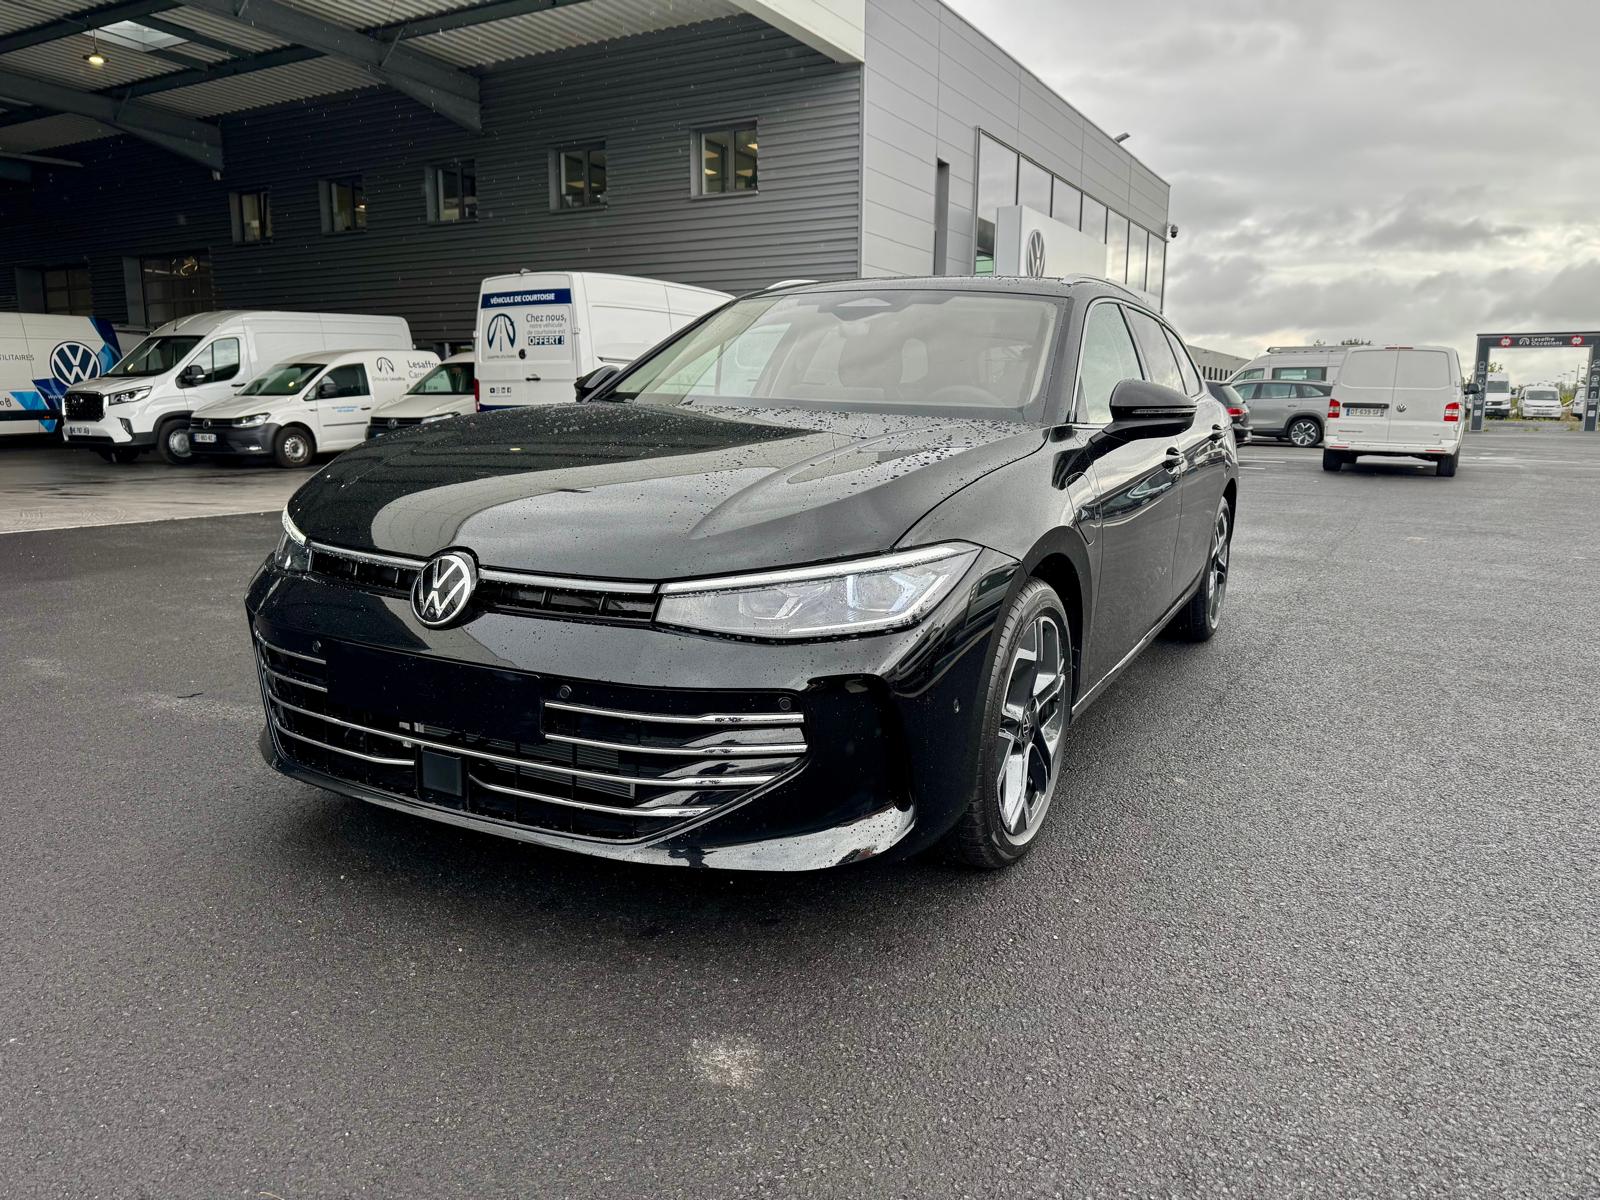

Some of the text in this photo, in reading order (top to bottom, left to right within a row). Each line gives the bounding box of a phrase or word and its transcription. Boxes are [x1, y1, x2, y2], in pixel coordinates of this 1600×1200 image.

[490, 292, 555, 304] VÉHICULE DE COURTOISIE
[526, 313, 543, 322] Chez
